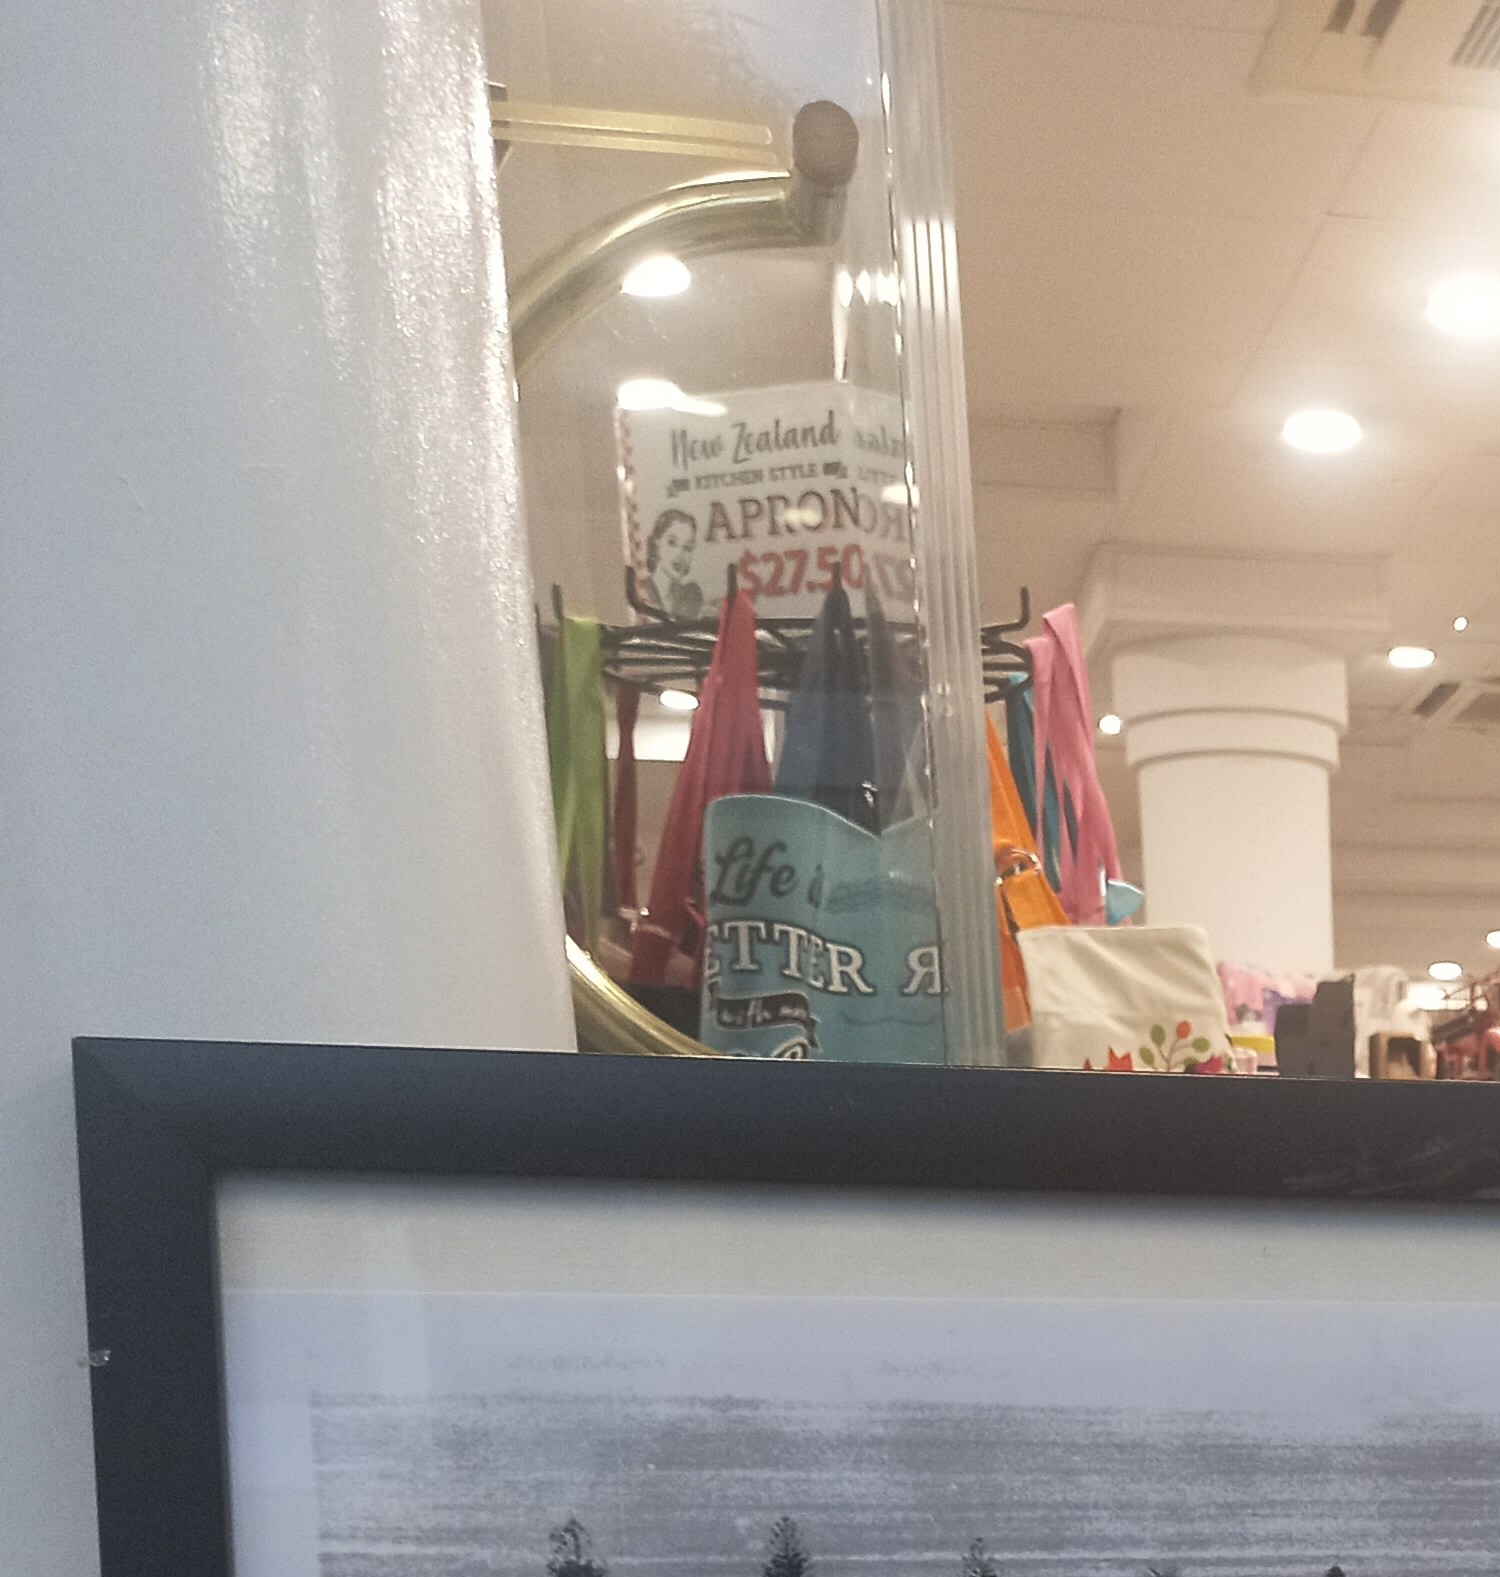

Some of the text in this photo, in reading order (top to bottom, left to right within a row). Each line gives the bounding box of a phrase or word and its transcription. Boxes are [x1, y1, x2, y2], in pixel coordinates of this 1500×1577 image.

[671, 428, 723, 470] New
[731, 410, 841, 465] Zealand
[694, 462, 818, 491] KITCHEN STYLE
[704, 487, 861, 543] APRON
[737, 544, 865, 597] $27.50
[709, 837, 797, 907] Life
